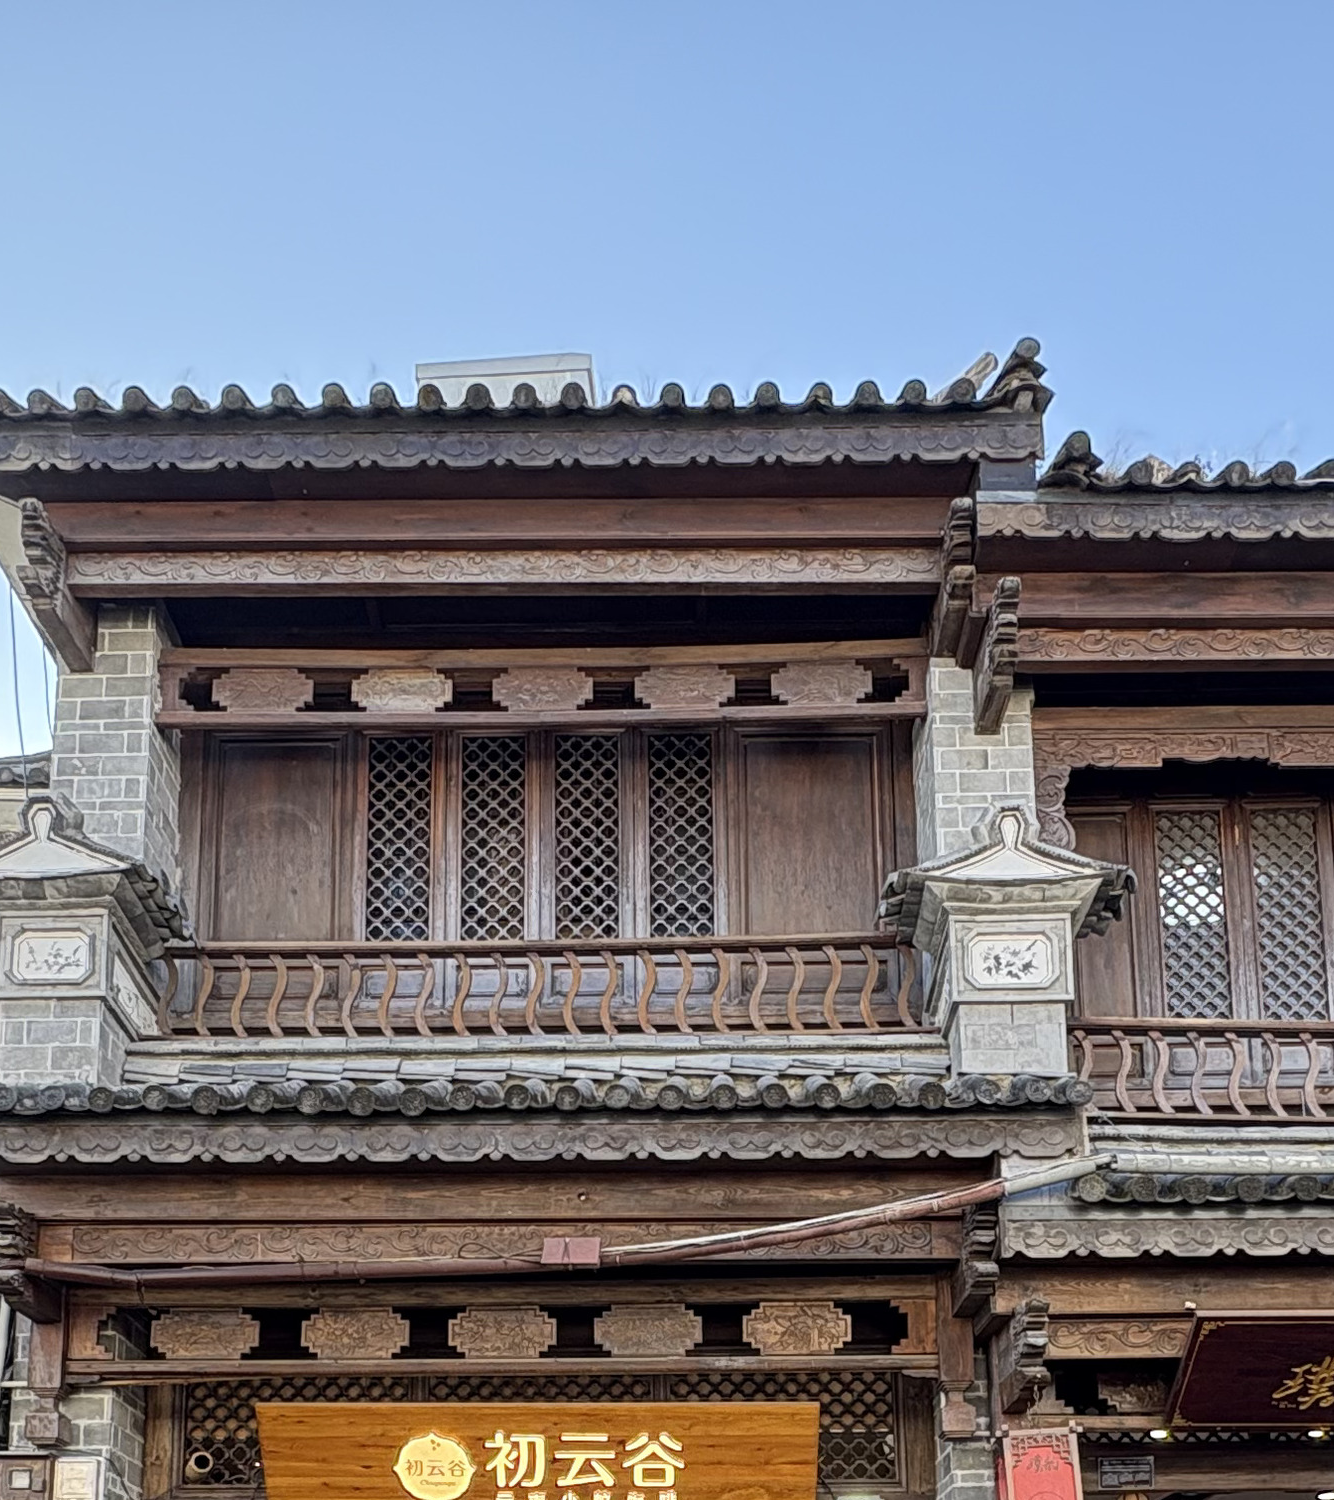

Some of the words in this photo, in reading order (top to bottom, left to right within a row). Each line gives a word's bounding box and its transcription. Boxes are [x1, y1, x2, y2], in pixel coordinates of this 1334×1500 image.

[404, 1459, 466, 1477] 初云谷
[484, 1429, 687, 1488] 初云谷
